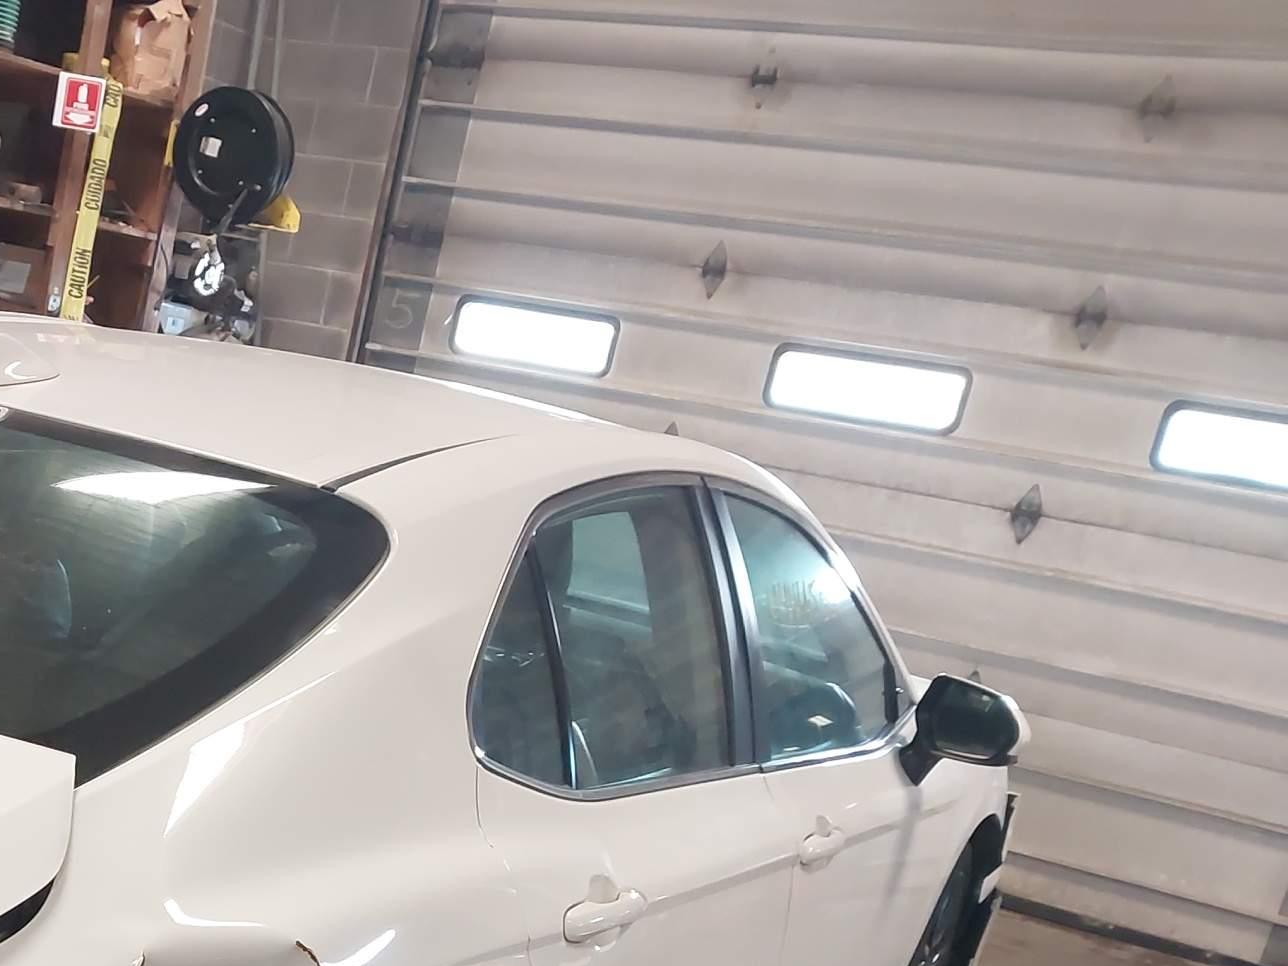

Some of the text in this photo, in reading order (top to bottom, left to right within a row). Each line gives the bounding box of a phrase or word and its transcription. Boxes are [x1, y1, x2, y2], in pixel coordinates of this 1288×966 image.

[68, 247, 92, 299] CAUTION
[84, 158, 108, 211] CUIDADO
[385, 287, 413, 329] 5
